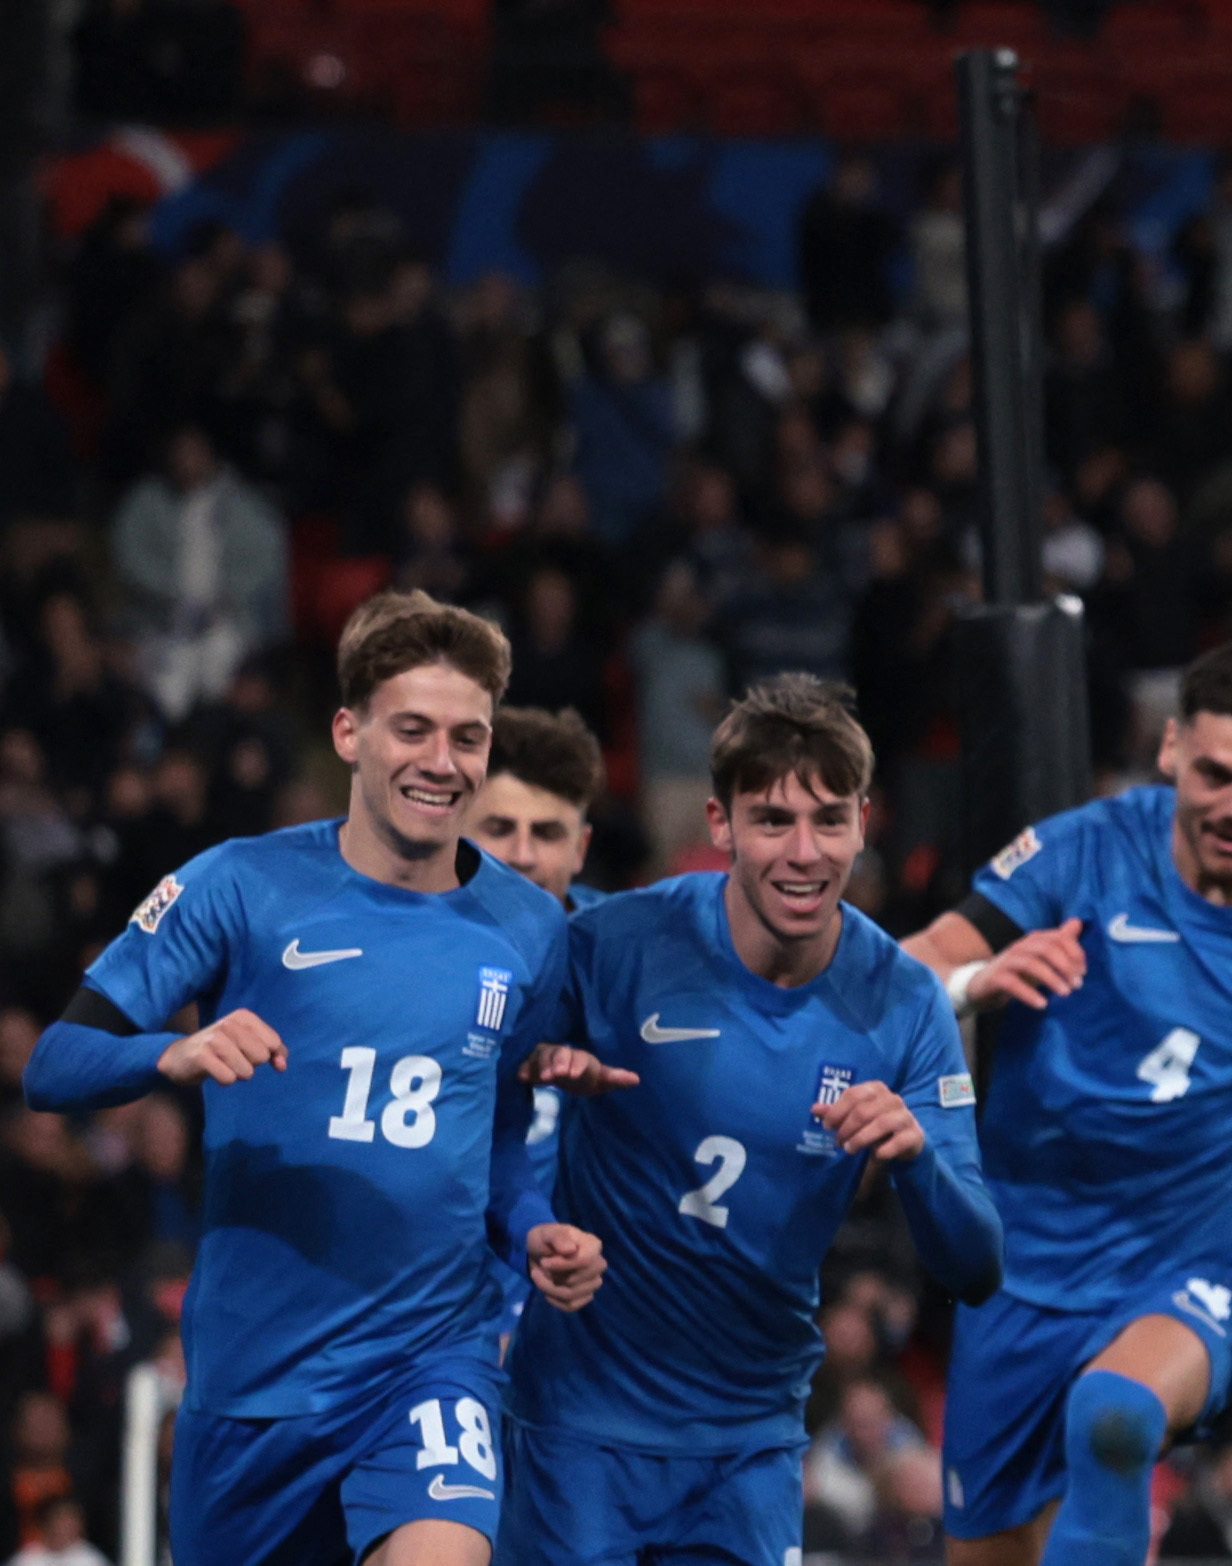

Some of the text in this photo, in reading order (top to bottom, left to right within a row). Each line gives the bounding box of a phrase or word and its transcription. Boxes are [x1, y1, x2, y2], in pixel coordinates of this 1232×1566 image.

[328, 1045, 443, 1149] 18
[1137, 1027, 1201, 1103] 4
[678, 1134, 747, 1229] 2
[409, 1396, 497, 1481] 18
